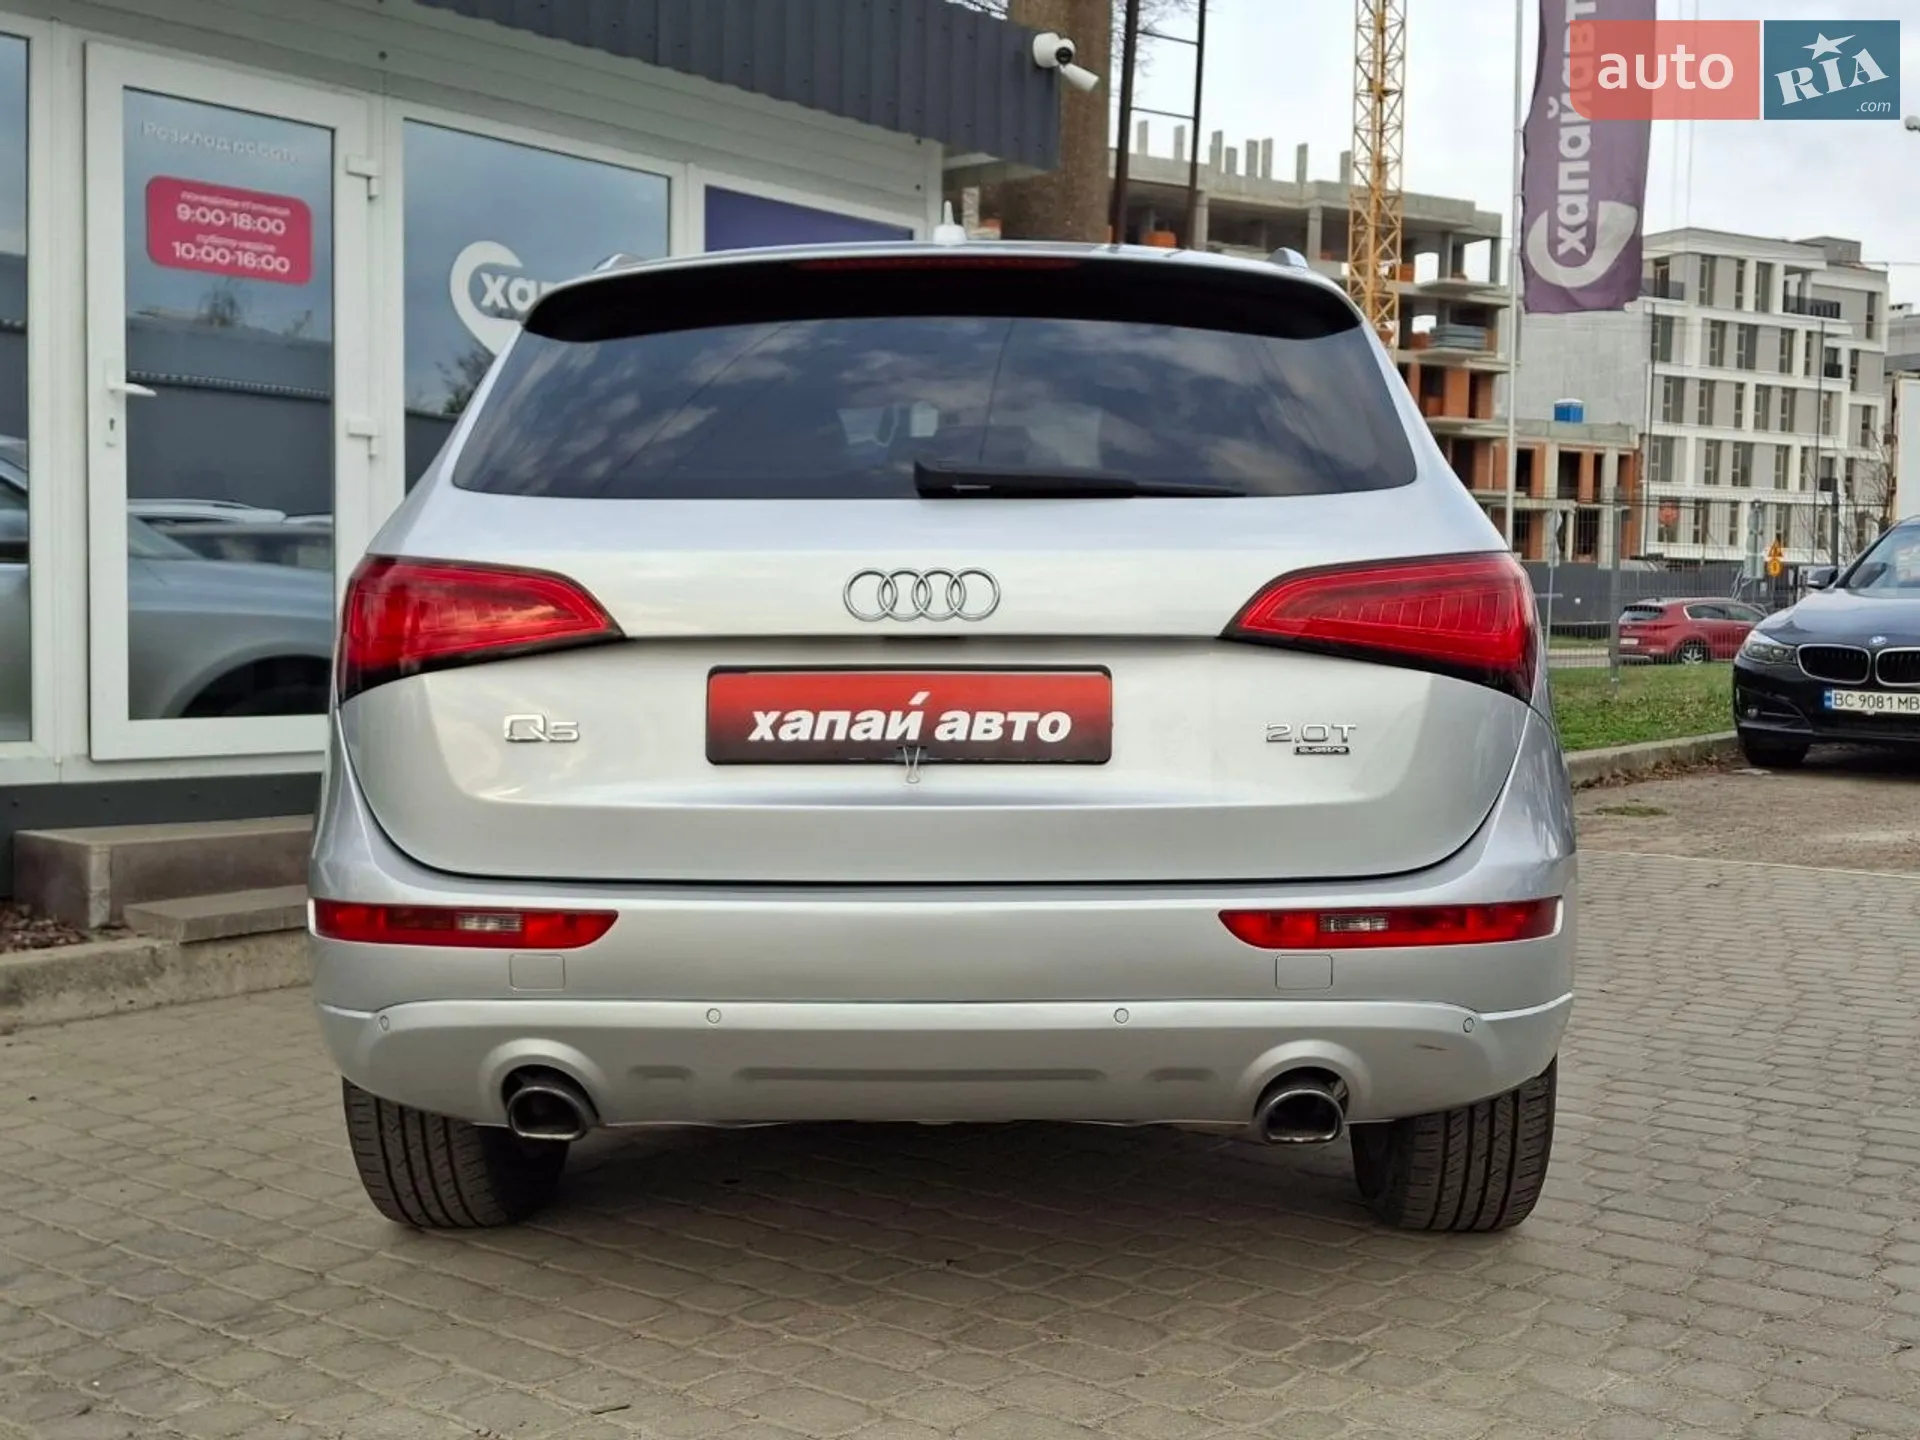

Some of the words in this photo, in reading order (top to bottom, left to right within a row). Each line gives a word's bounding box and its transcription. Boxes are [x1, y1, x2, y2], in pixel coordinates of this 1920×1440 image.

[176, 203, 286, 236] 9:00-18:00
[172, 241, 291, 274] 10:00-16:00
[480, 272, 562, 312] ха
[1858, 694, 1893, 709] 9081
[504, 714, 579, 742] Q5
[934, 709, 1073, 742] авто
[1266, 724, 1357, 743] 2.0T
